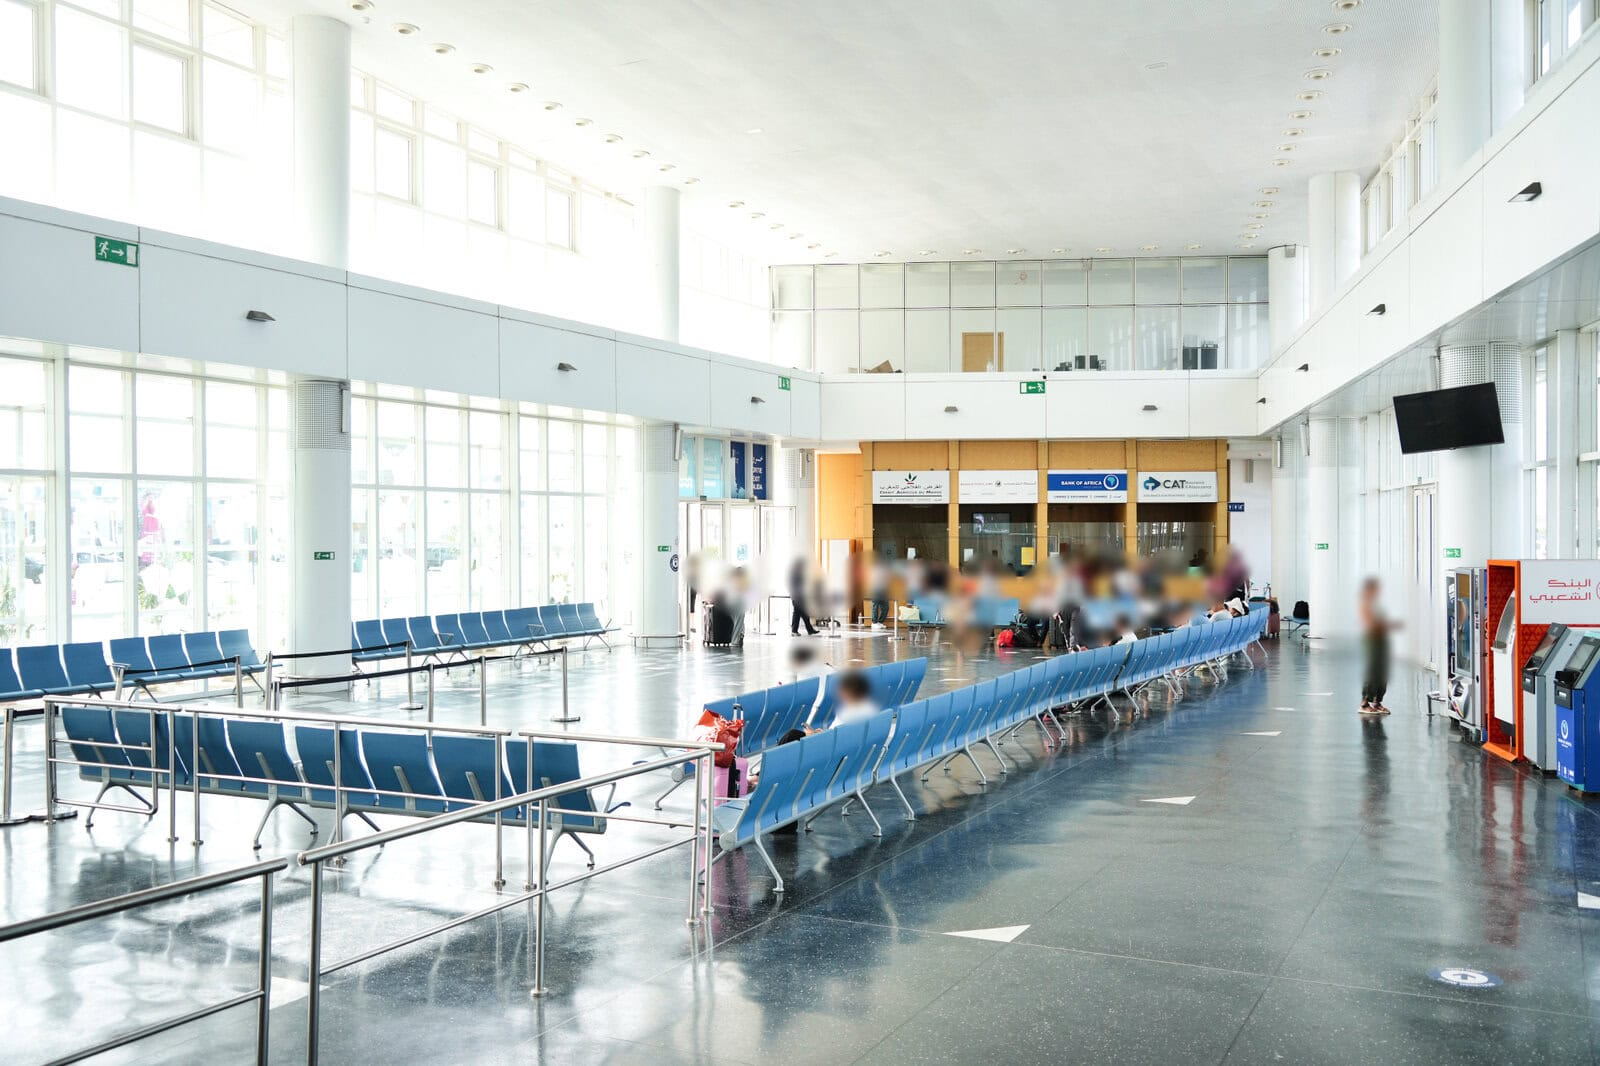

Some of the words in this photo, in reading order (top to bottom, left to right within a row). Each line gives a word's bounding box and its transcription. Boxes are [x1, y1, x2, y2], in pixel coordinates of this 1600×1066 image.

[1163, 480, 1186, 488] CAT
[1548, 578, 1591, 590] البنك
[1529, 592, 1591, 603] الشعبي
